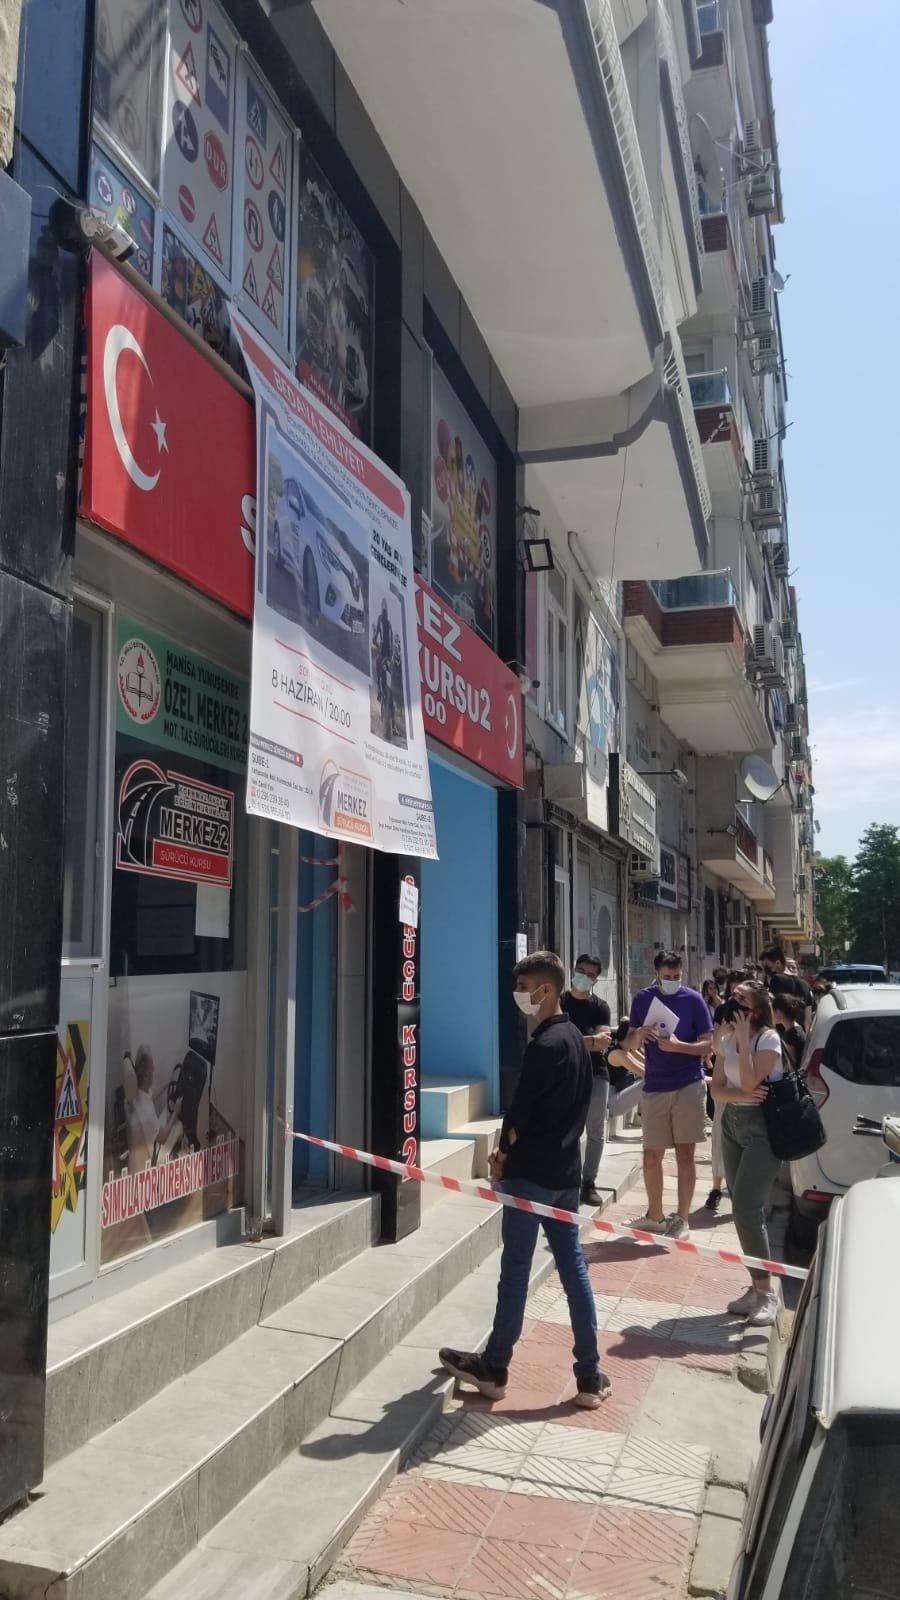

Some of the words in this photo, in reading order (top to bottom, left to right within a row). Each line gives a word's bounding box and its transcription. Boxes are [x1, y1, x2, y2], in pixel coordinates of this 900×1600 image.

[206, 140, 227, 179] DUR
[166, 650, 196, 680] MANİSA
[164, 668, 194, 723] ÖZEL
[197, 692, 239, 743] MERKEZ
[272, 669, 279, 688] 8
[281, 674, 324, 712] HAZİRAN
[418, 641, 491, 731] URSU2
[337, 790, 368, 818] MERKEZ
[160, 848, 189, 865] SÜRÜCÜ
[190, 855, 212, 870] KURSU
[402, 1024, 417, 1133] KURSU
